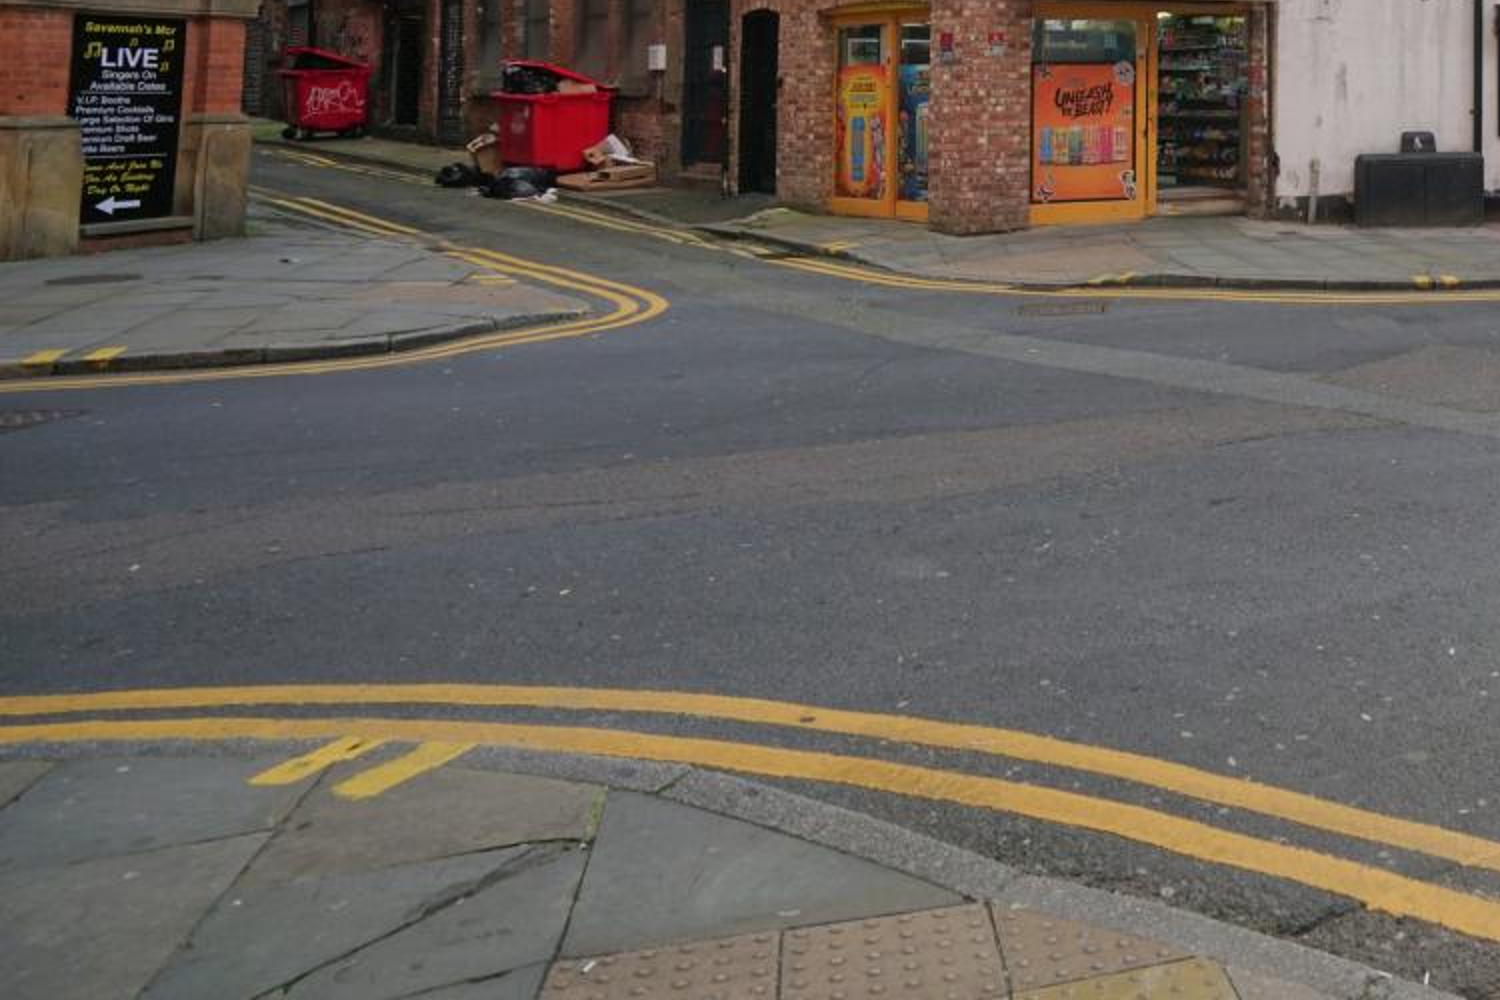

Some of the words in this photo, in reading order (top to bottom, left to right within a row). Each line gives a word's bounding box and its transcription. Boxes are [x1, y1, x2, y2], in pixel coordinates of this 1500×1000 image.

[101, 47, 159, 68] LIVE
[101, 69, 140, 81] Singers
[142, 70, 157, 79] On
[90, 81, 135, 91] Available
[137, 81, 166, 91] Dates
[1056, 82, 1114, 109] UNLEASH
[75, 105, 115, 115] Premium
[116, 105, 154, 115] Cocktails
[102, 115, 141, 124] Selection
